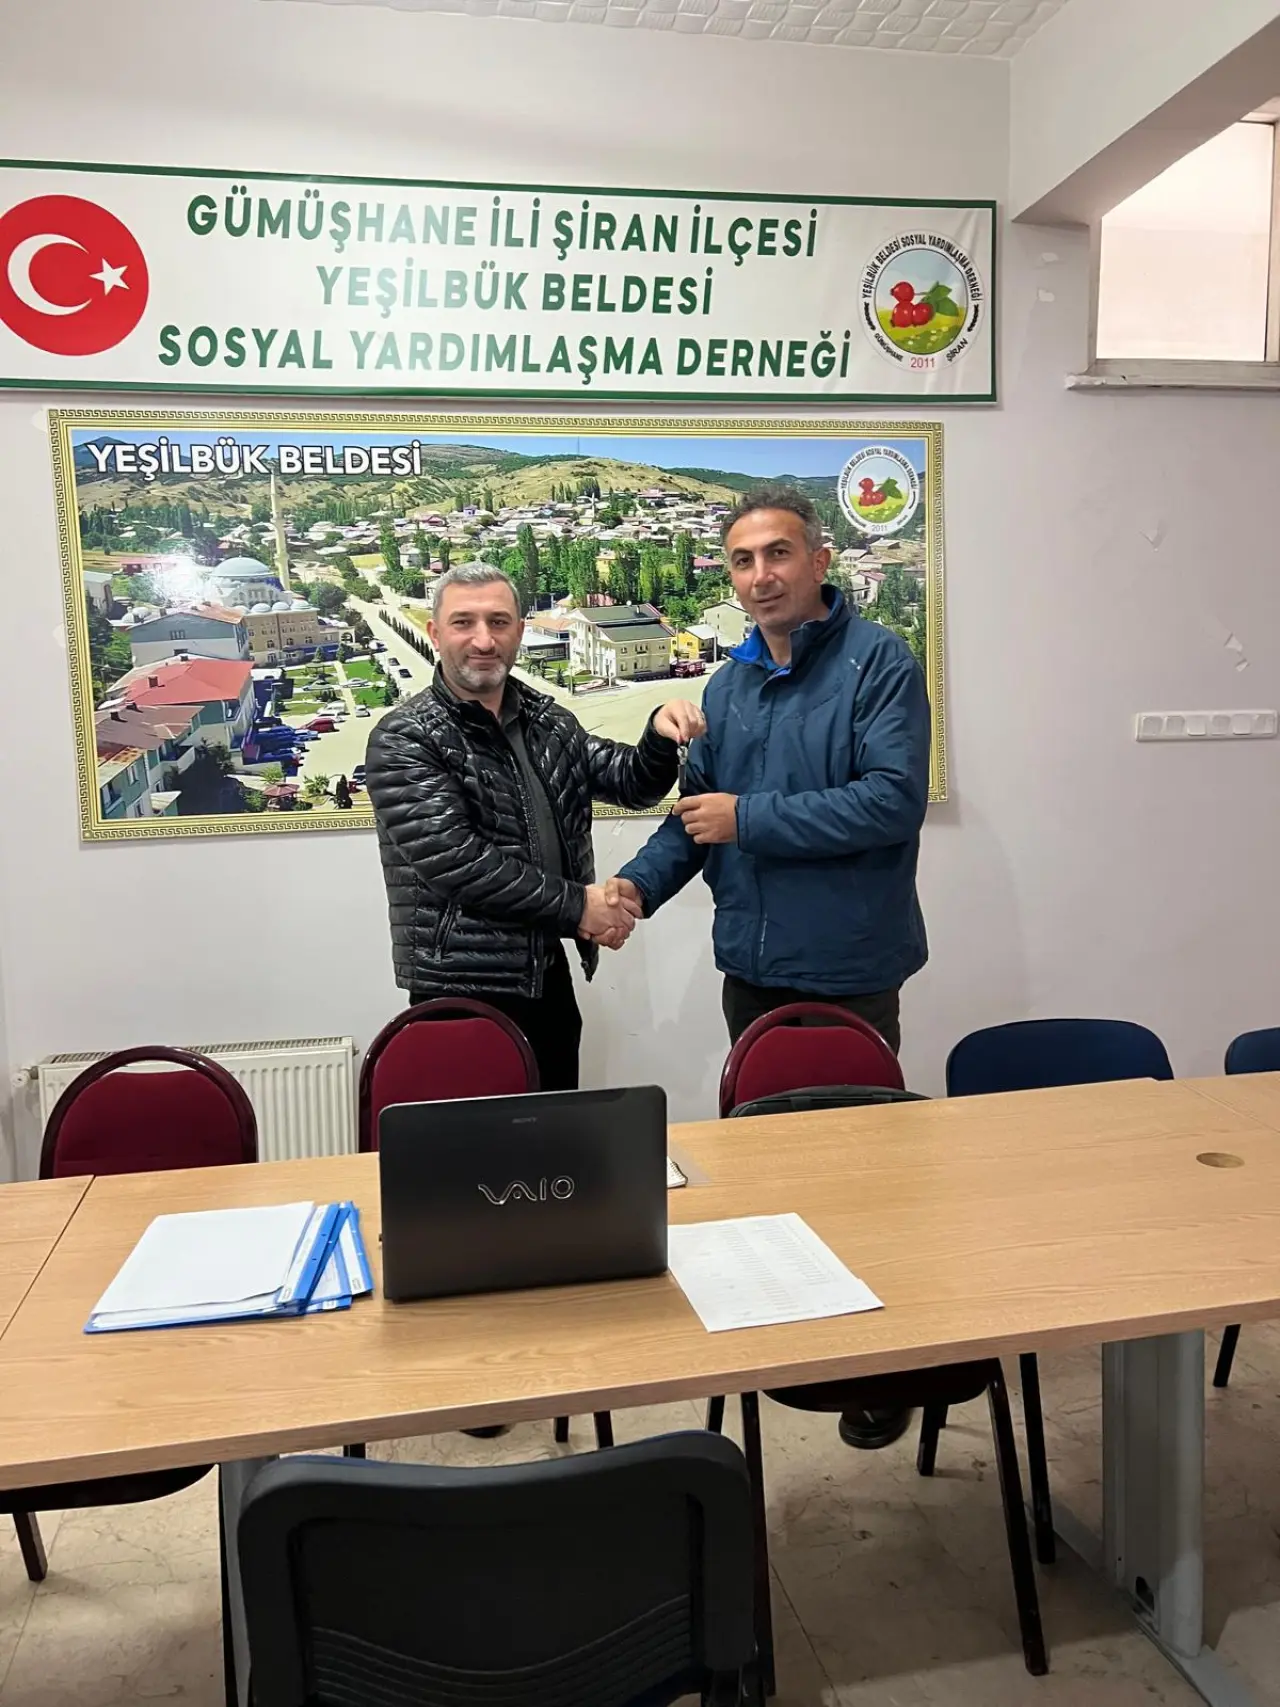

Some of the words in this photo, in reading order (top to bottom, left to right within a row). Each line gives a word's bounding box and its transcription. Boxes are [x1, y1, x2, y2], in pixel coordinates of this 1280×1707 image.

[187, 185, 477, 253] GÜMÜŞHANE
[490, 195, 541, 248] İLİ
[553, 199, 678, 261] ŞİRAN
[690, 204, 818, 266] İLÇESİ
[876, 236, 902, 266] BELDESİ
[901, 234, 927, 248] SOSYAL
[316, 257, 529, 319] YEŞİLBÜK
[542, 266, 713, 315] BELDESİ
[158, 324, 333, 369] SOSYAL
[350, 330, 663, 385] YARDIMLAŞMA
[676, 329, 851, 378] DERNEĞİ
[910, 357, 935, 368] 2011
[86, 436, 273, 481] YEŞİLBÜK
[278, 439, 422, 476] BELDESİ
[478, 1175, 575, 1205] VAIO
